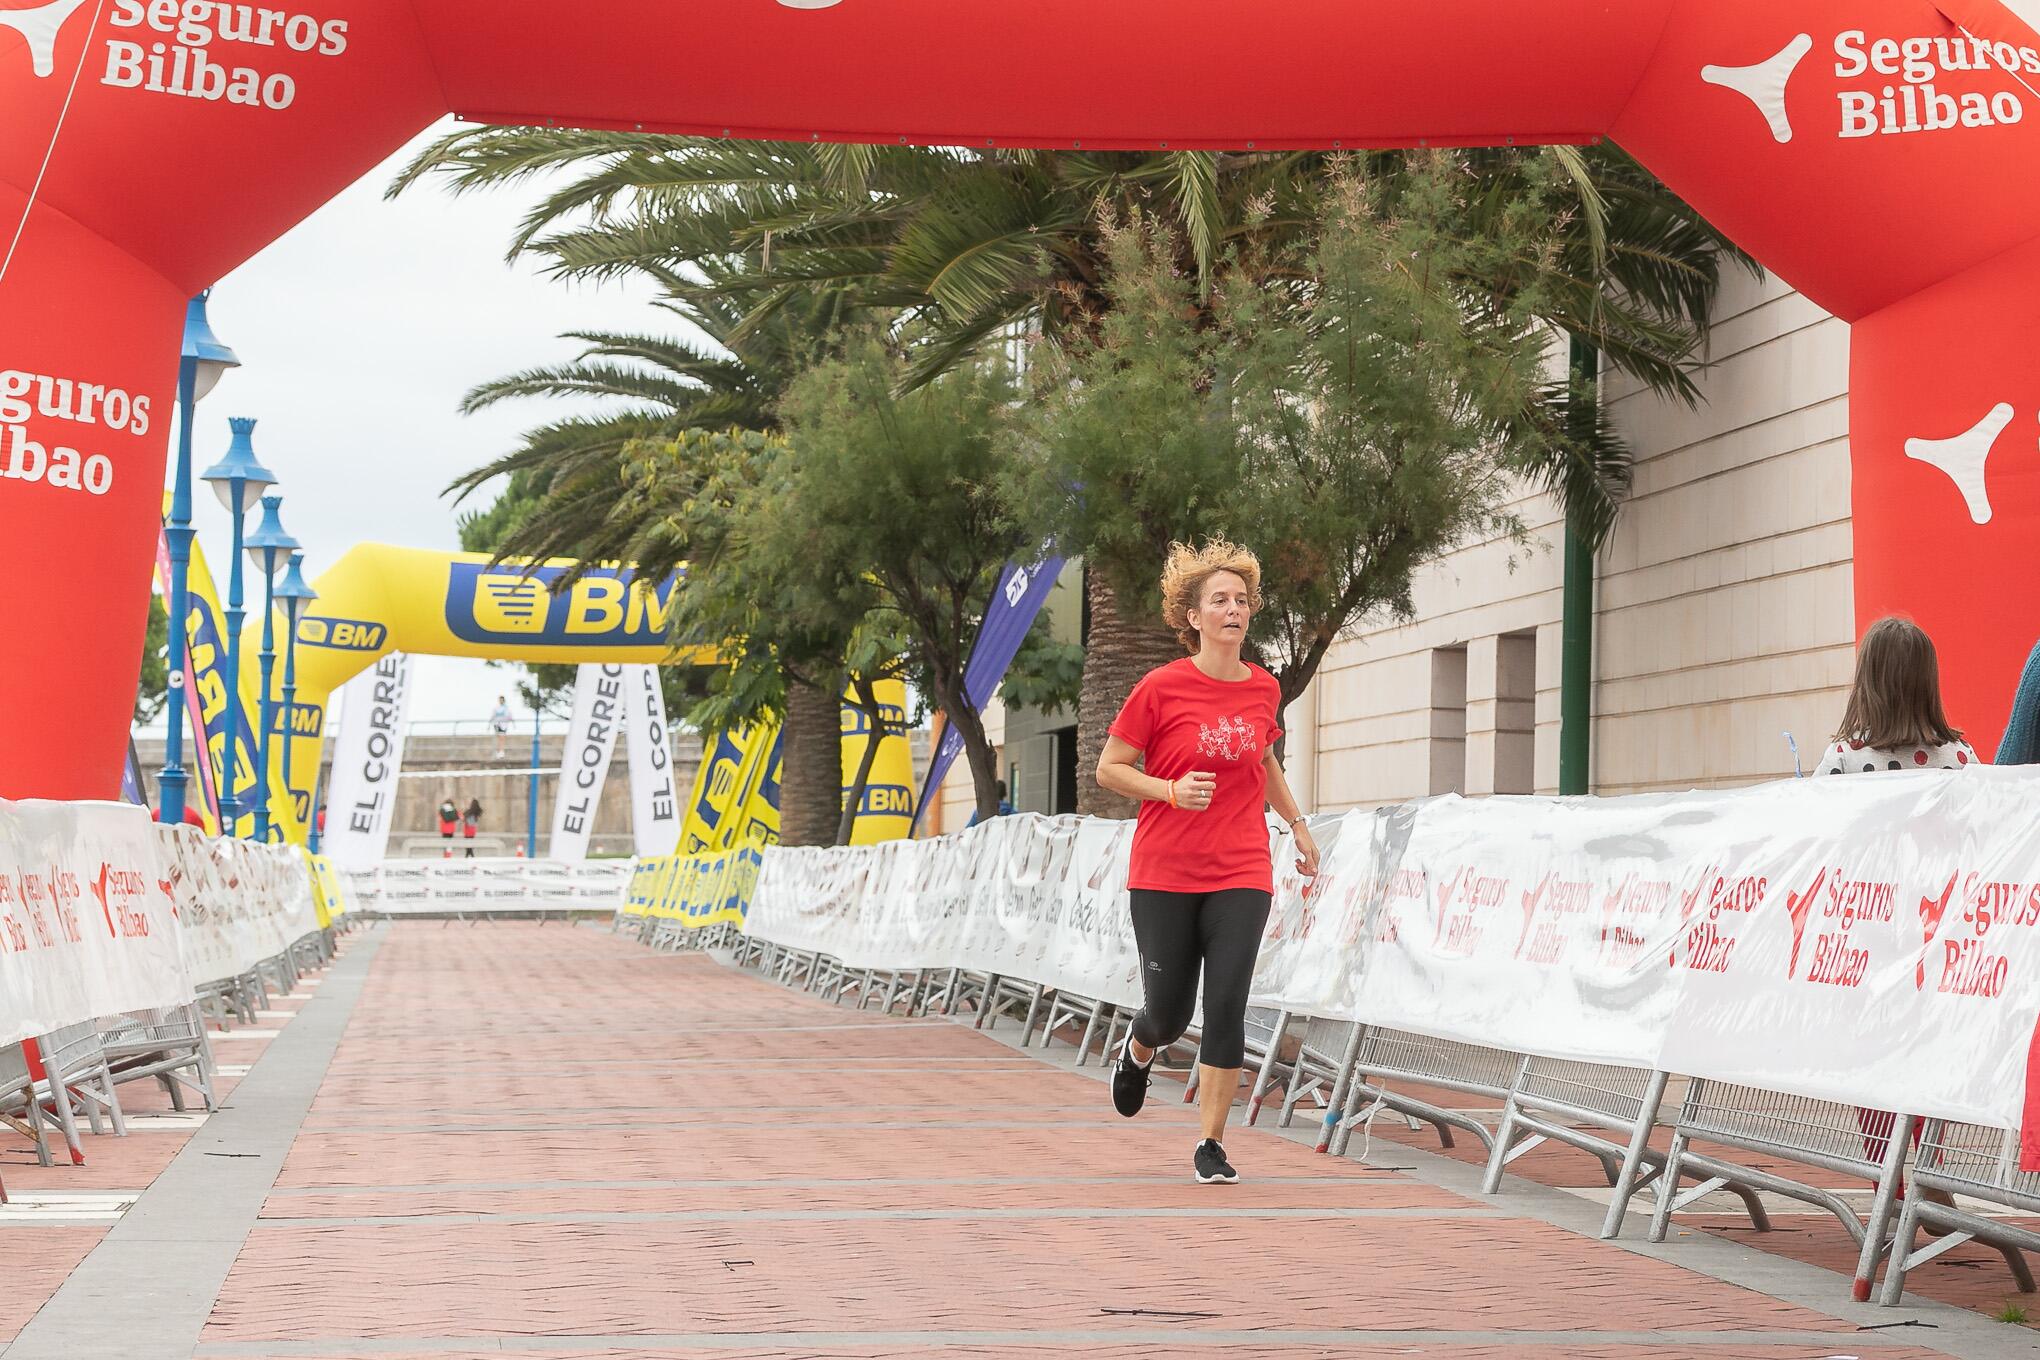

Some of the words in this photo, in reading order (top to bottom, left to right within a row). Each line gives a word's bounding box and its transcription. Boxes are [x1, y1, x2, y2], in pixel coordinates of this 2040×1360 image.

[109, 0, 348, 56] Seguros
[100, 39, 296, 110] Bilbao
[1834, 30, 2040, 83] Seguros
[1837, 83, 2023, 138] Bilbao
[0, 424, 113, 495] bao
[331, 622, 382, 648] BM
[350, 792, 379, 833] EL
[563, 798, 590, 834] EL
[653, 777, 673, 820] EL
[868, 788, 909, 812] BM
[1824, 868, 1899, 930] Seguros
[1807, 932, 1868, 987] Bilbao
[1938, 938, 2008, 998] Bilbao
